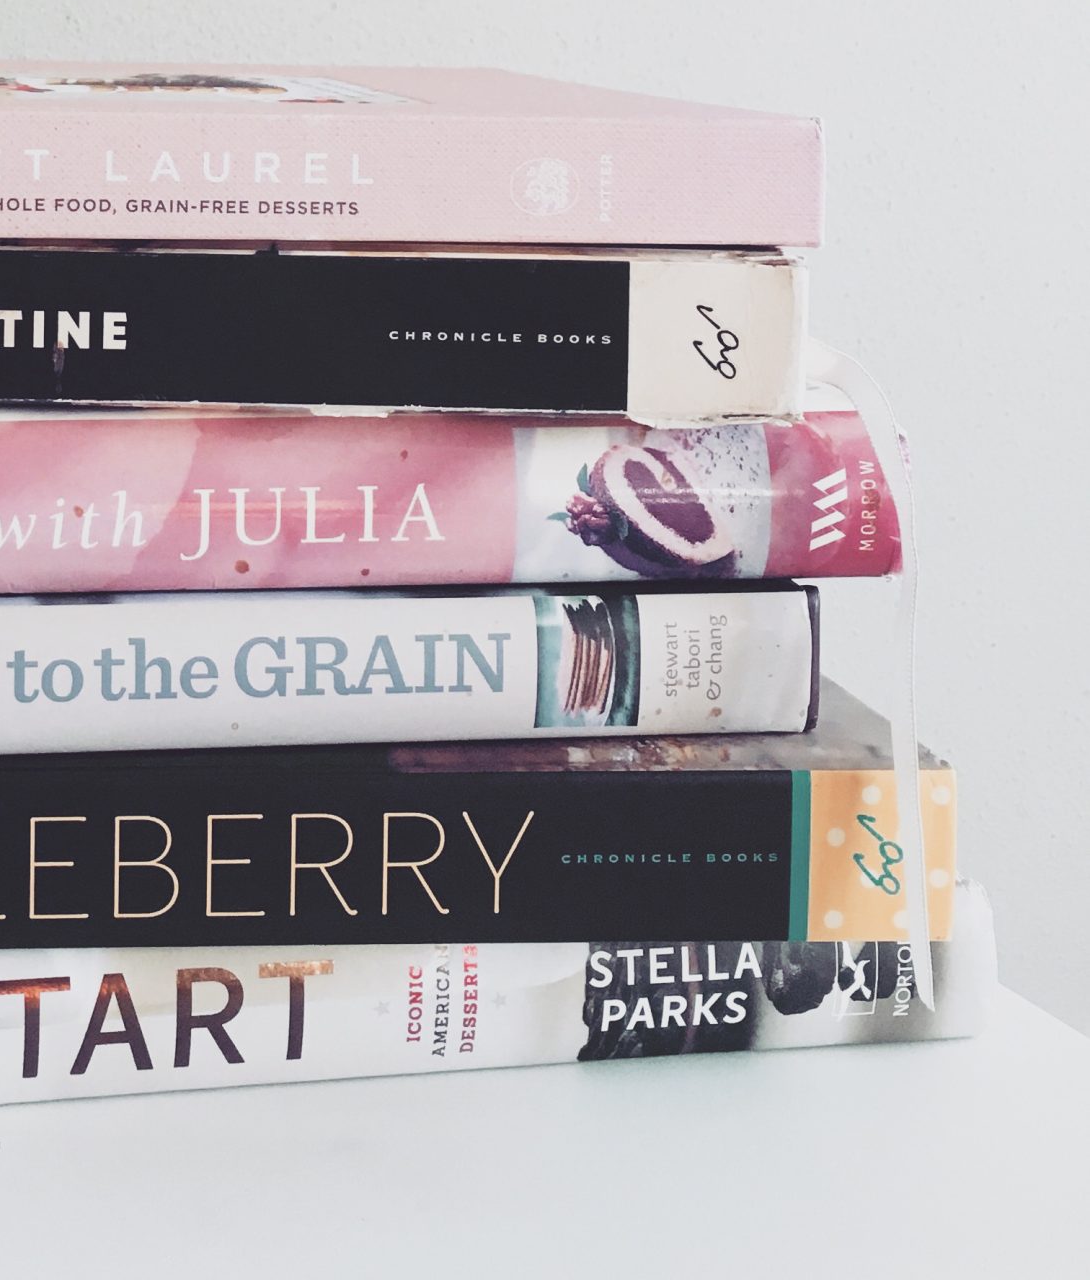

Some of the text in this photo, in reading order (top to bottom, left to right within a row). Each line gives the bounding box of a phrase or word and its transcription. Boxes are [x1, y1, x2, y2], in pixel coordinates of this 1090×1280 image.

[104, 150, 376, 186] LAUREL
[54, 198, 118, 216] FOOD,
[125, 199, 251, 215] GRAIN-FREE
[257, 201, 361, 217] DESSERTS
[388, 330, 613, 346] CHRONICLE BOOKS
[181, 482, 446, 561] JULIA
[859, 459, 875, 552] MORROW
[6, 648, 84, 703] to
[93, 637, 219, 701] the
[233, 632, 511, 698] GRAIN
[665, 621, 679, 698] stewart
[683, 628, 701, 690] tabori
[705, 613, 727, 674] chang
[560, 852, 781, 865] CHRONICLE BOOKS
[589, 942, 763, 988] STELLA
[892, 941, 914, 1017] NORTO
[406, 965, 424, 1044] ICONIC
[431, 944, 451, 1058] AMERICAN
[459, 944, 479, 1054] DESSERTS
[600, 991, 748, 1032] PARKS
